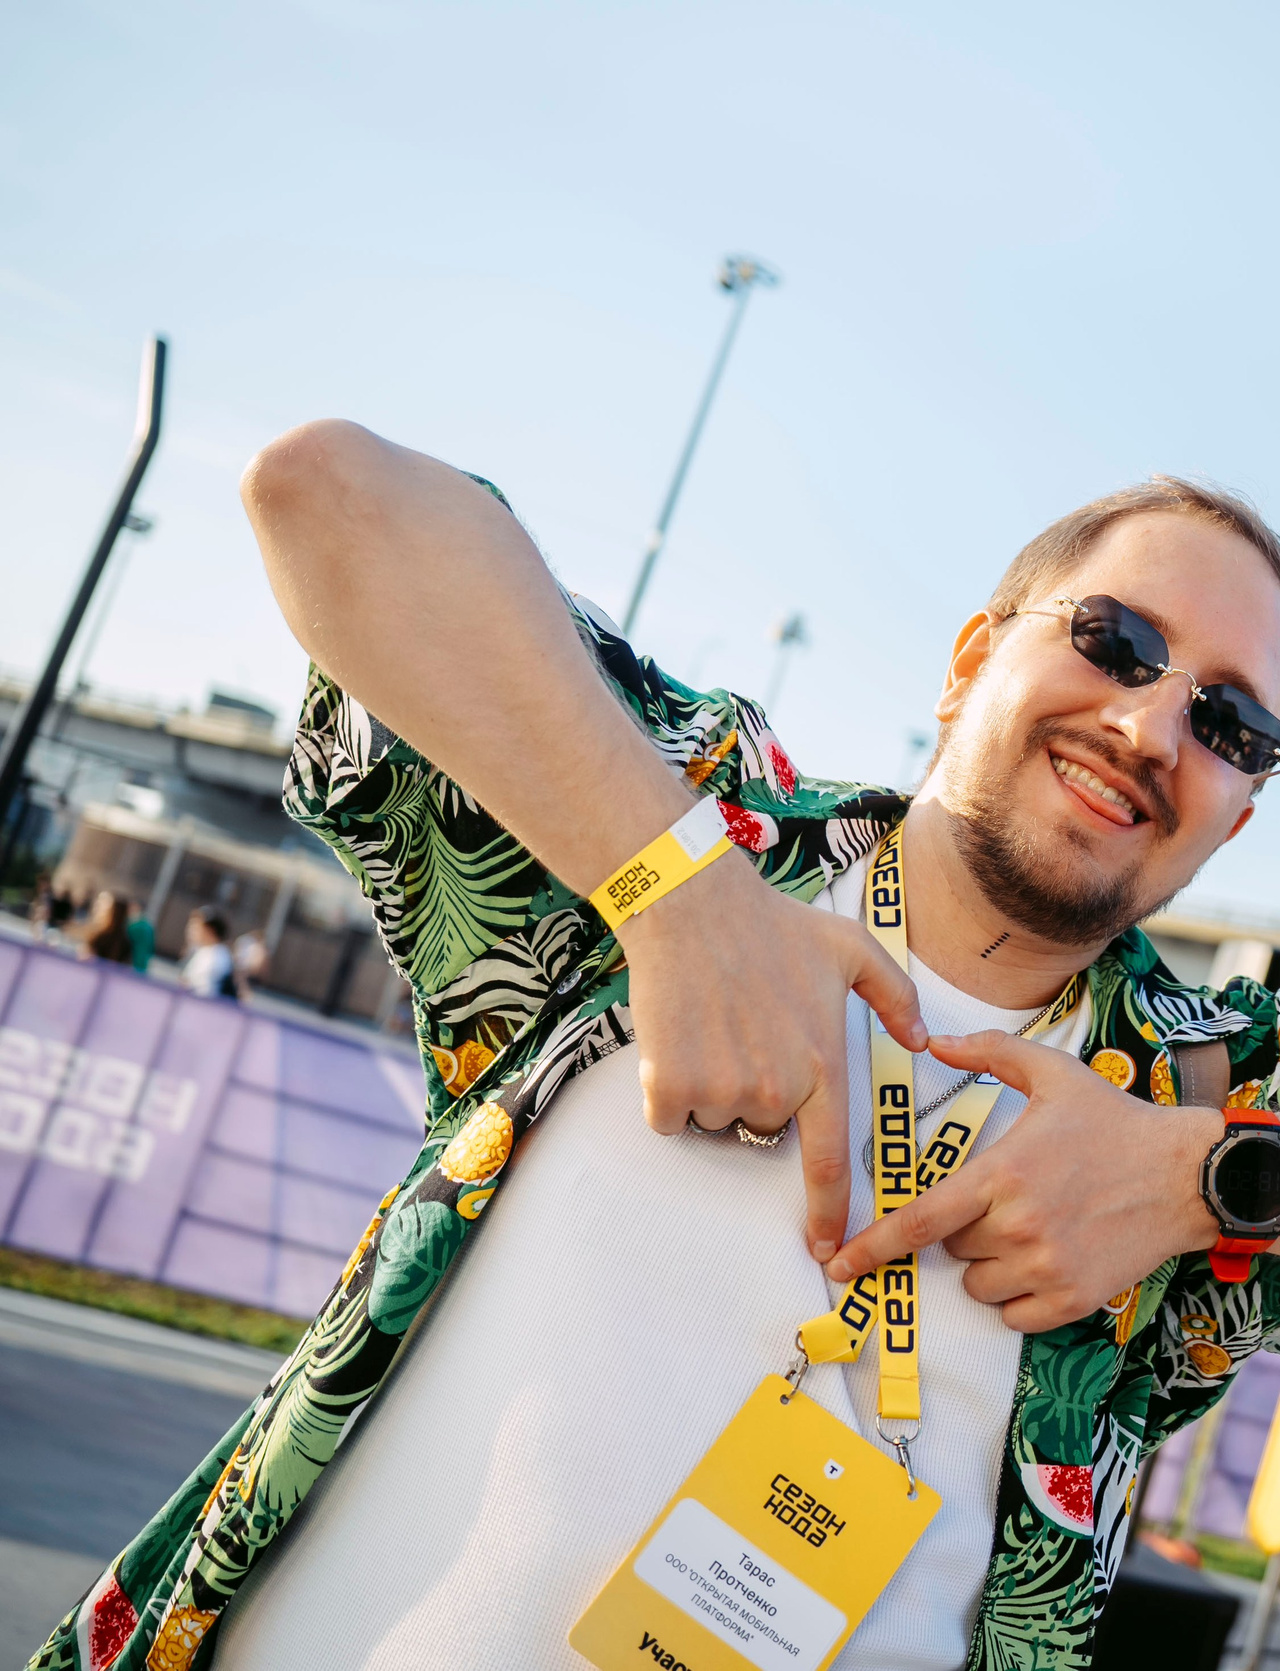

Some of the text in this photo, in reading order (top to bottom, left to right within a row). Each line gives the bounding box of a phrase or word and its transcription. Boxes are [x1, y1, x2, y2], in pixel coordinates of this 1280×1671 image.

[607, 861, 648, 898] кода
[613, 870, 660, 912] сезон
[879, 1083, 912, 1195] кода
[917, 1121, 972, 1196] сез
[763, 1493, 828, 1548] кода
[770, 1473, 847, 1537] сезон
[708, 1560, 778, 1617] Протченко
[738, 1552, 776, 1588] Тарас
[665, 1553, 688, 1573] ООО
[739, 1608, 801, 1657] МОБИЛЬНАЯ
[691, 1593, 754, 1643] ПЛАТФОРМА"
[638, 1631, 695, 1671] Учас
